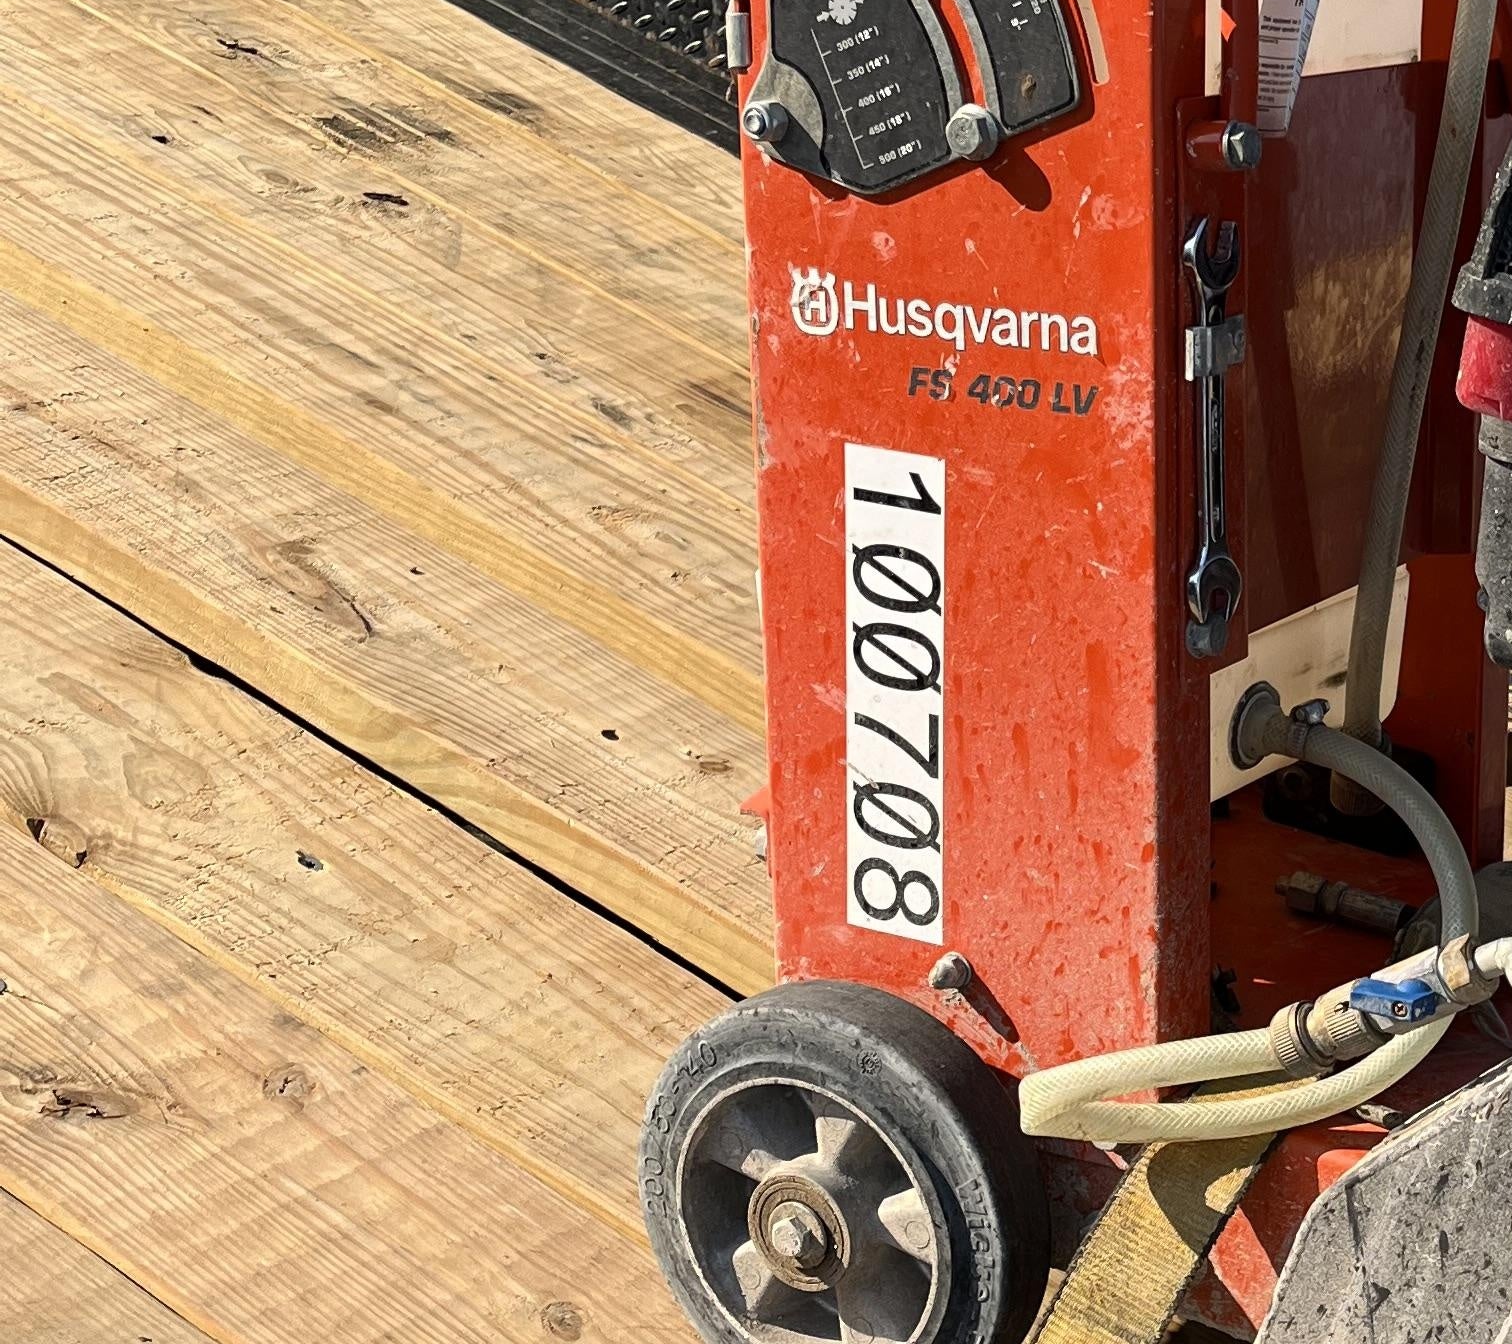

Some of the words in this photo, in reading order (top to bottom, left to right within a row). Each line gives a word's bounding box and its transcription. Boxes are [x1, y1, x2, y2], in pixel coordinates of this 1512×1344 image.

[836, 38, 854, 52] 300
[847, 66, 864, 80] 350
[858, 94, 875, 108] 400
[869, 123, 886, 136] 450
[843, 281, 1099, 359] Husqvarna
[908, 368, 953, 401] FS
[967, 375, 1040, 411] 400
[1051, 381, 1099, 416] LV
[852, 472, 942, 924] 100708
